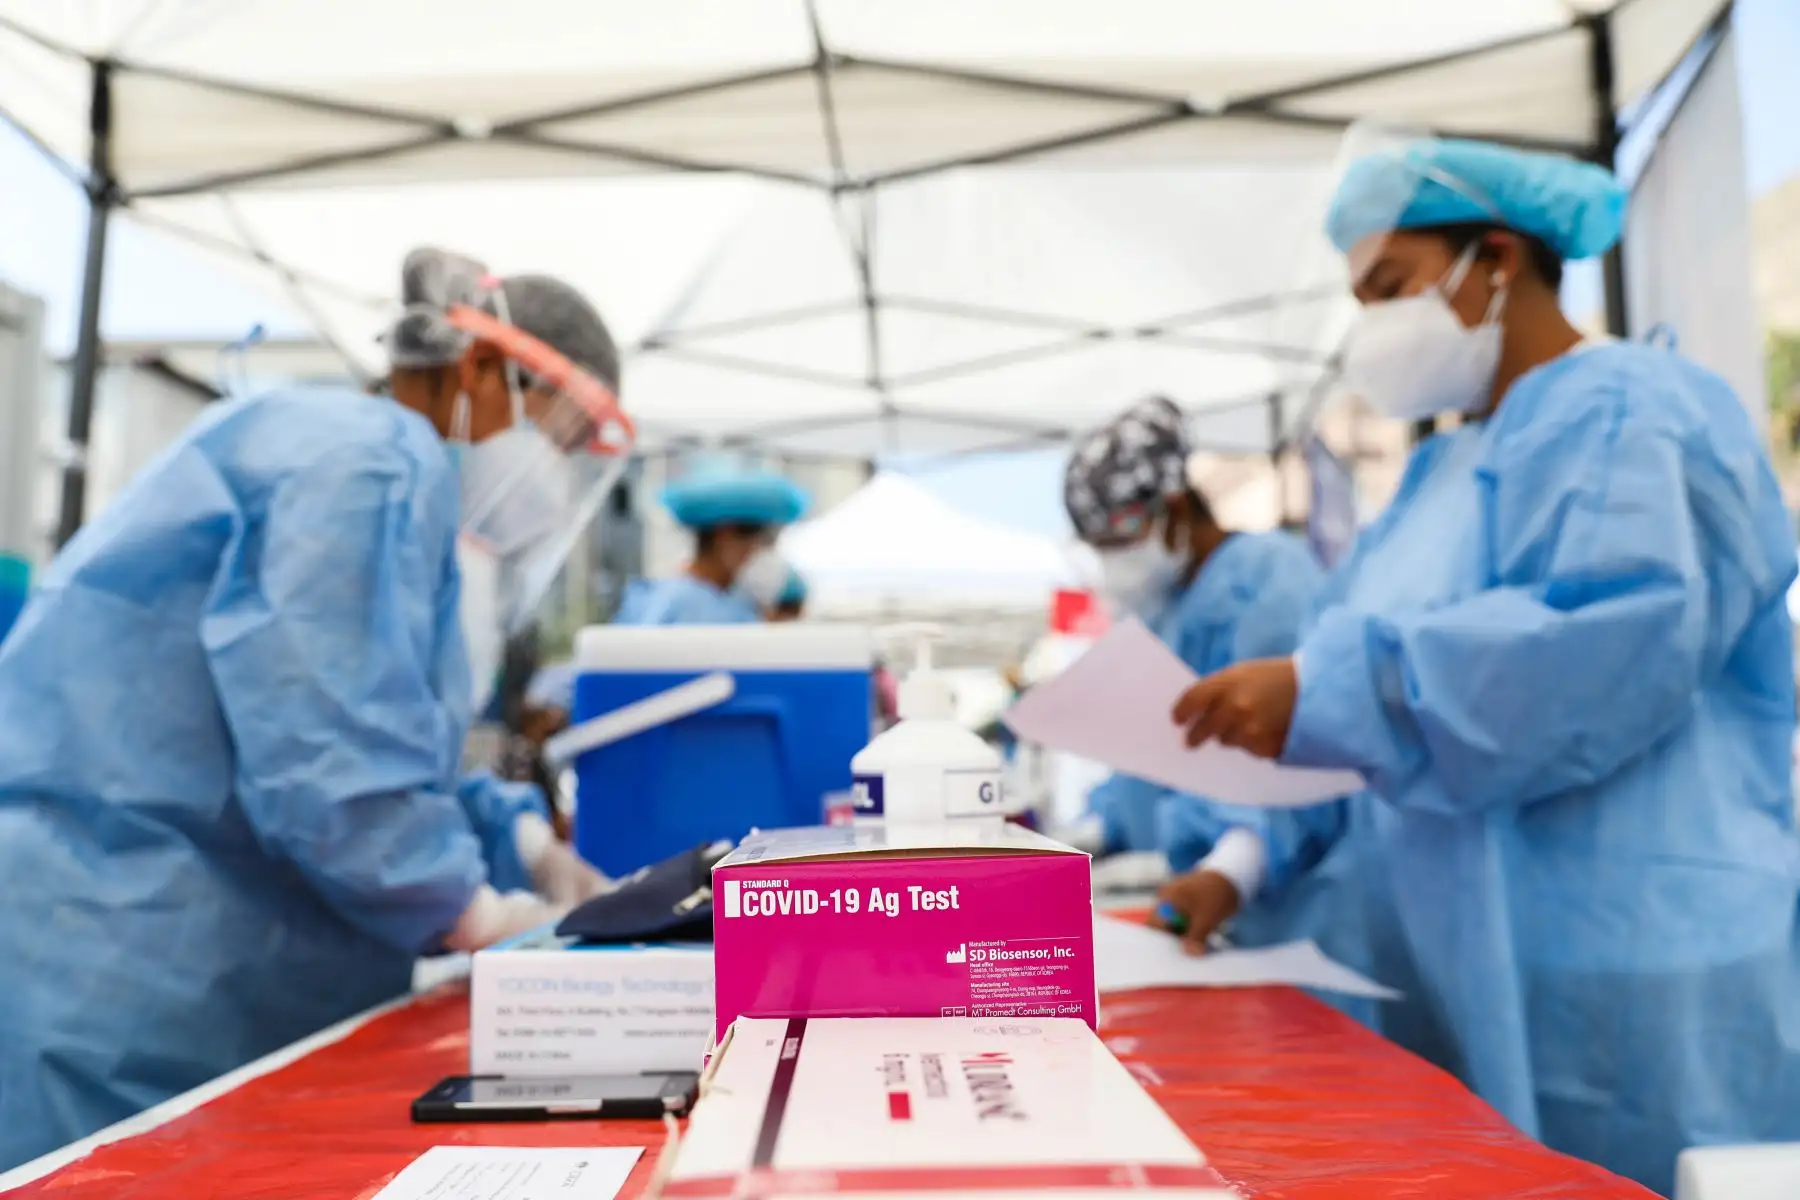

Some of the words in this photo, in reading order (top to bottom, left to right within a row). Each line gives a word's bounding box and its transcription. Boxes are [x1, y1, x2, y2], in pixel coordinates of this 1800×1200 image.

[743, 880, 781, 888] STANDARD
[743, 888, 860, 916] COVID-19
[868, 887, 899, 917] Ag
[907, 885, 959, 910] Test
[970, 949, 986, 961] SD
[989, 948, 1051, 960] Biosensor,
[1054, 946, 1075, 957] Inc.
[972, 1009, 983, 1018] MT
[1018, 1005, 1055, 1016] Consulting
[1057, 1003, 1082, 1014] GmbH
